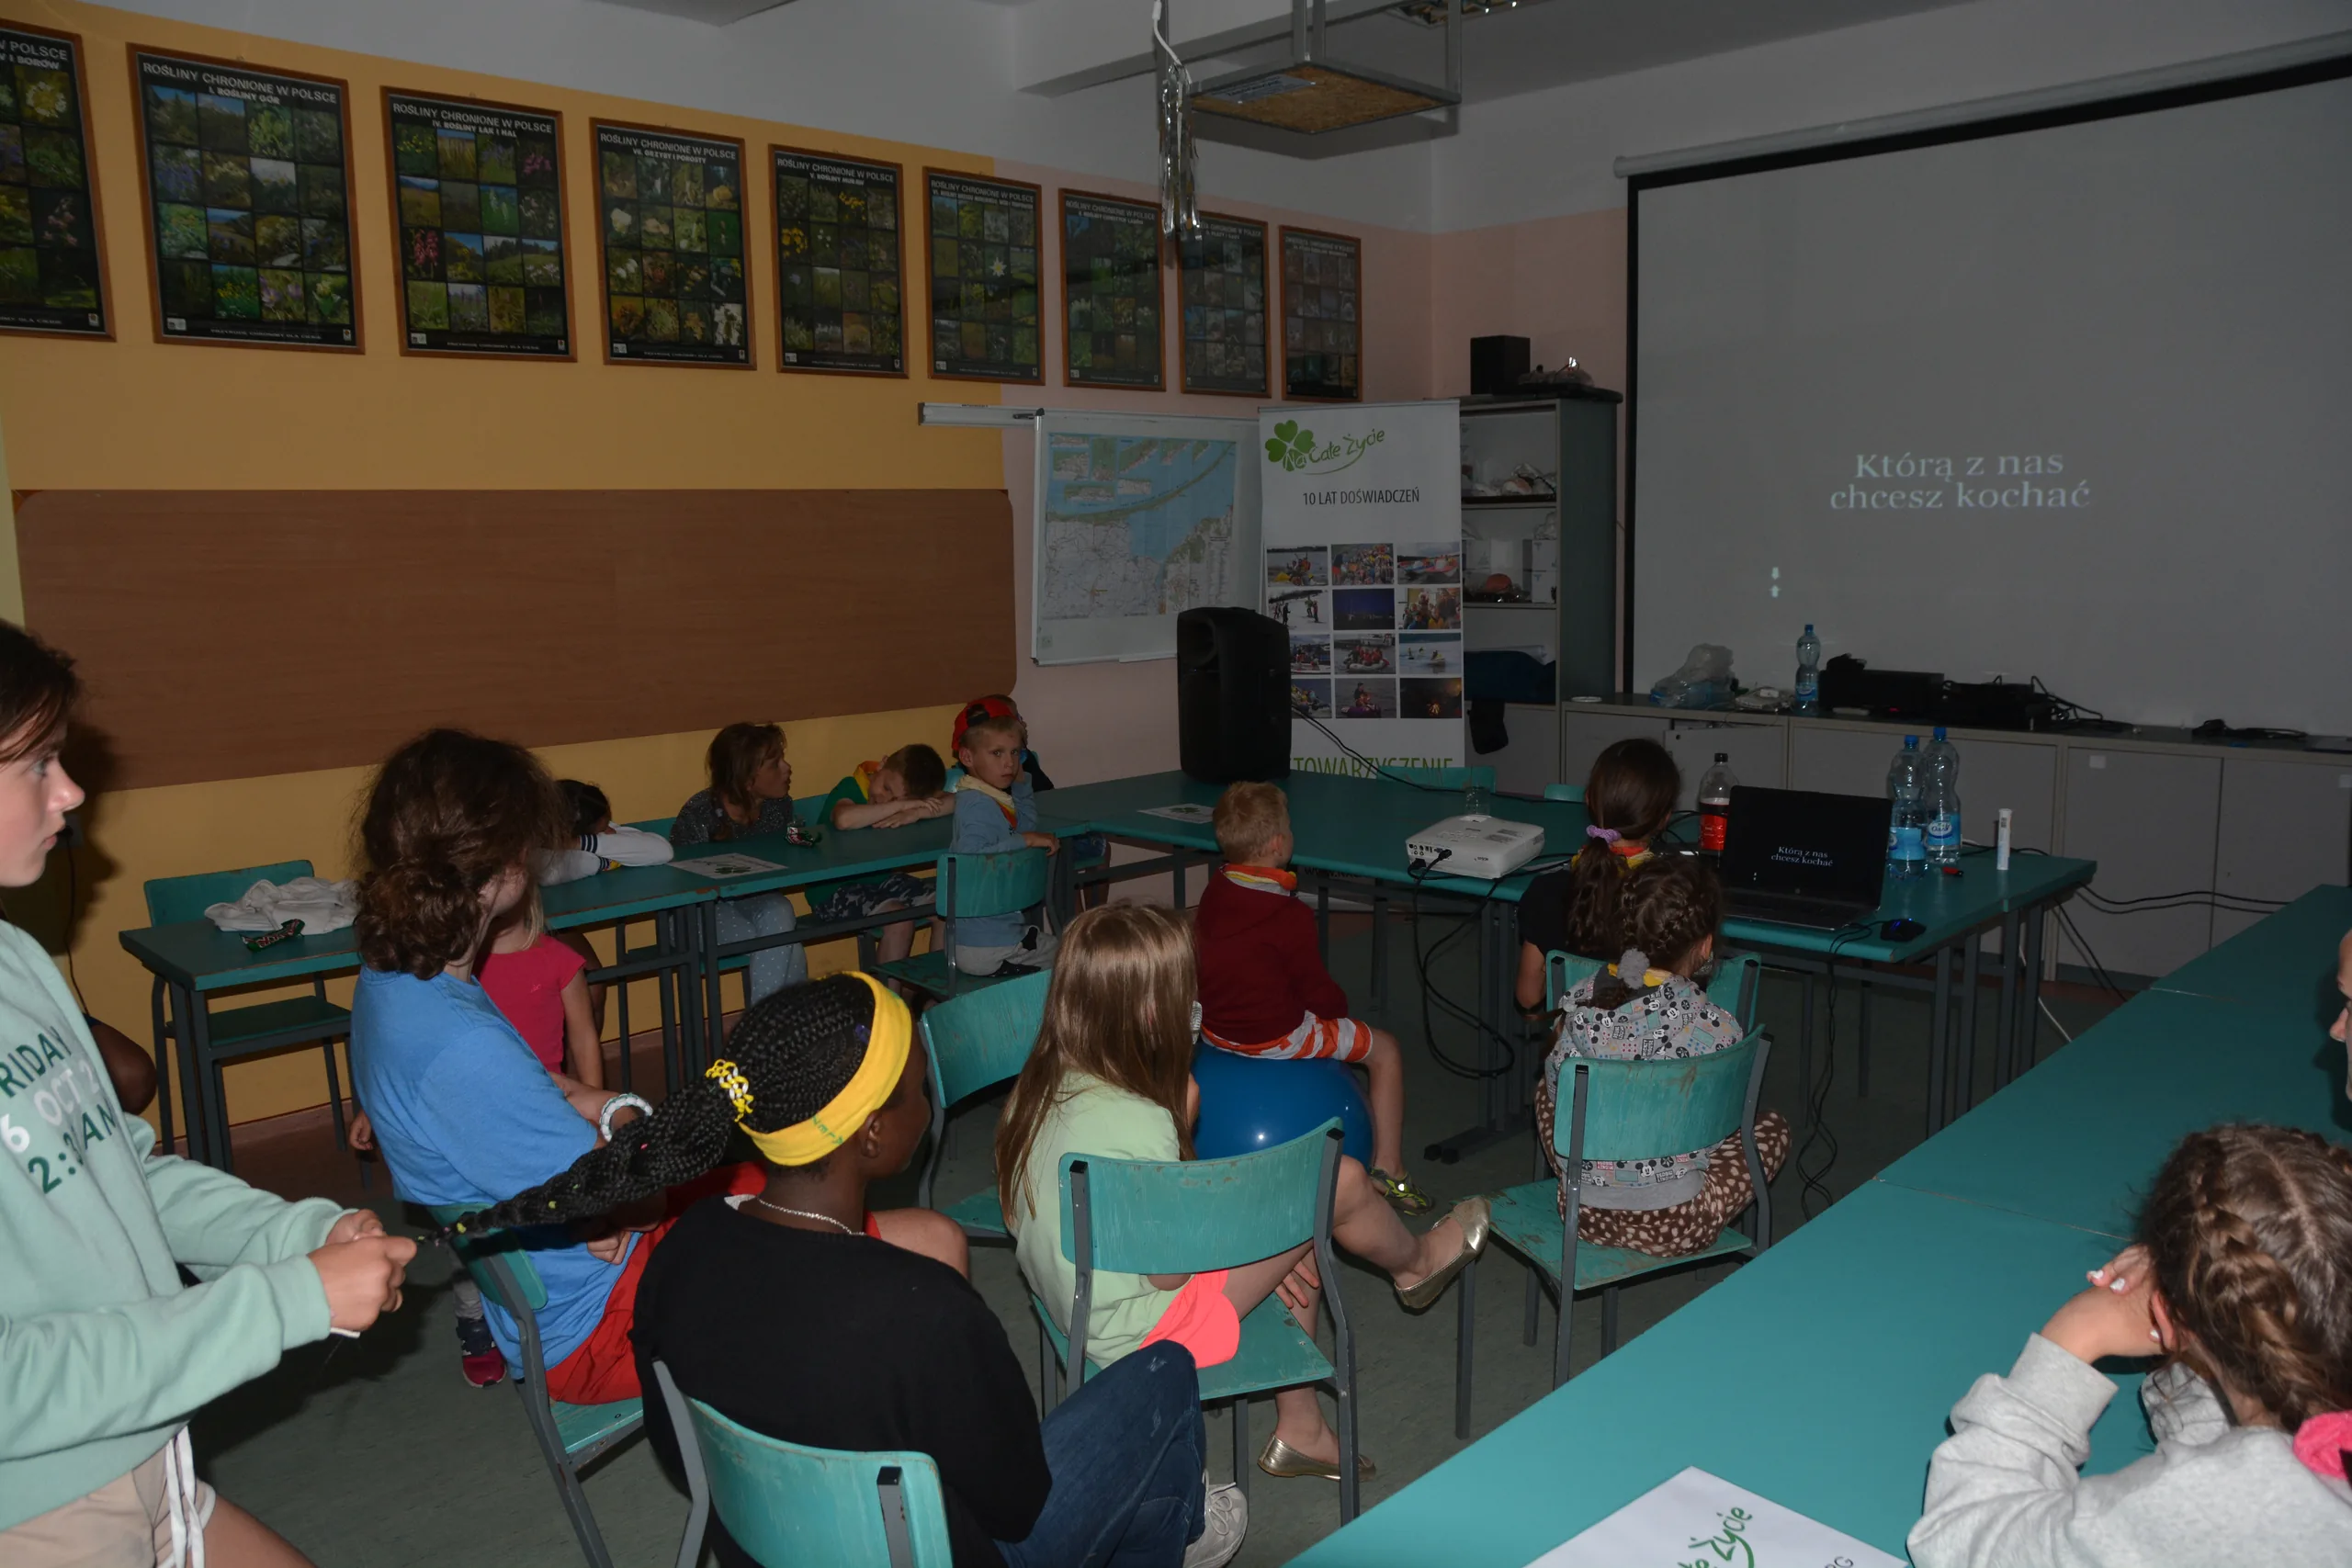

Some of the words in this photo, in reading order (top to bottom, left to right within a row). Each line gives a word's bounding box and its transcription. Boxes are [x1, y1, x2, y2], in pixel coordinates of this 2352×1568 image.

[10, 41, 68, 61] POLSCE
[17, 55, 60, 71] BORÓW
[142, 62, 198, 82] ROŚLINY
[202, 73, 274, 94] CHRONIONE
[276, 85, 290, 96] W
[292, 88, 337, 104] POLSCE
[217, 87, 257, 100] ROŚLINY
[259, 94, 280, 105] GÓR
[392, 103, 438, 118] ROŚLINY
[441, 109, 500, 127] CHRONIONE
[502, 118, 514, 129] W
[514, 119, 553, 134] POLSCE
[443, 121, 477, 133] ROŚLINY
[600, 133, 639, 147] ROŚLINY
[640, 138, 692, 154] CHRONIONE
[693, 146, 703, 155] W
[704, 148, 737, 161] POLSCE
[645, 150, 672, 160] GRZYBY
[676, 153, 707, 164] POROSTY
[777, 158, 809, 171] ROŚLINY
[812, 164, 855, 177] CHRONIONE
[856, 170, 865, 179] W
[866, 172, 894, 184] POLSCE
[931, 179, 960, 191] ROŚLINY
[961, 186, 1000, 198] CHRONIONE
[1001, 191, 1009, 199] W
[1010, 193, 1035, 203] POLSCE
[1133, 211, 1156, 220] POLSCE
[1283, 450, 1306, 471] Na
[1308, 441, 1341, 463] Całe
[1342, 428, 1385, 457] Życie
[1854, 451, 1954, 482] Którą
[1965, 456, 1984, 476] z
[1997, 454, 2064, 476] nas
[1303, 491, 1317, 505] 10
[1318, 491, 1338, 505] LAT
[1340, 487, 1420, 504] DOŚWIADCZEŃ
[1829, 483, 1944, 510] chcesz
[1955, 479, 2091, 508] kochać
[1770, 853, 1800, 863] chcesz
[1802, 856, 1834, 867] kochać
[1778, 846, 1804, 857] Którą
[1812, 851, 1828, 859] nas
[33, 1068, 81, 1126] OCT
[1688, 1506, 1753, 1562] Życie
